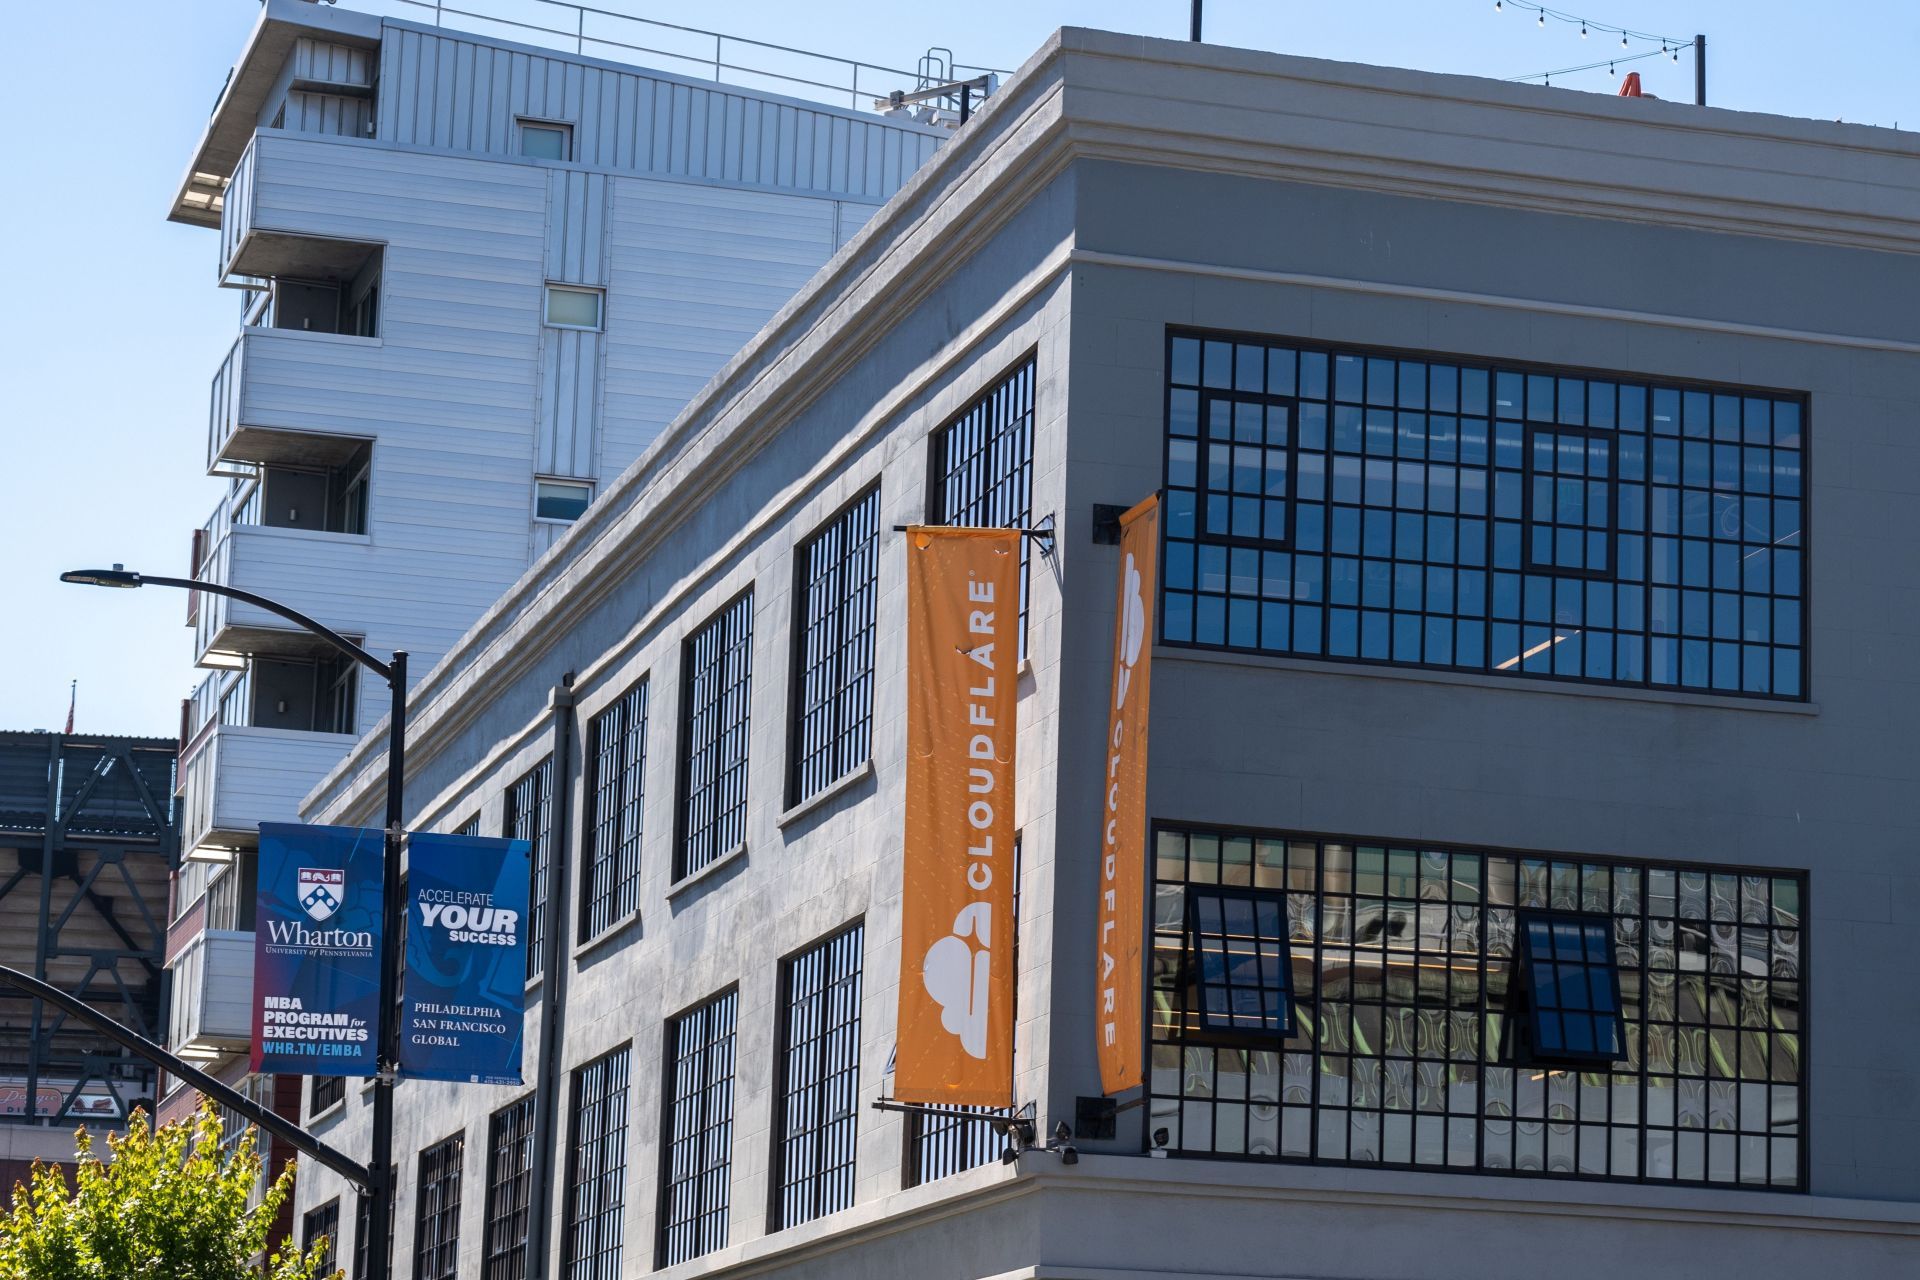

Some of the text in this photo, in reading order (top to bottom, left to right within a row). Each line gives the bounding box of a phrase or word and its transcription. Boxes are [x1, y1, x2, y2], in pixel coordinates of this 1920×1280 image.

[418, 888, 494, 907] ACCELERATE
[418, 902, 518, 934] YOUR
[266, 920, 373, 948] Wharton
[449, 930, 517, 946] SUCCESS
[265, 946, 373, 958] UNIVERSITY of PENNSYLVANIA
[264, 996, 303, 1010] MBA
[414, 1002, 502, 1018] PHILADELPHIA
[263, 1011, 367, 1028] PROGRAM for
[413, 1018, 506, 1034] SAN FRANCISCO
[263, 1025, 369, 1042] EXECUTIVES
[411, 1034, 460, 1047] GLOBAL
[262, 1041, 362, 1057] WHR.TN/EMBA
[0, 1090, 58, 1105] Dogie
